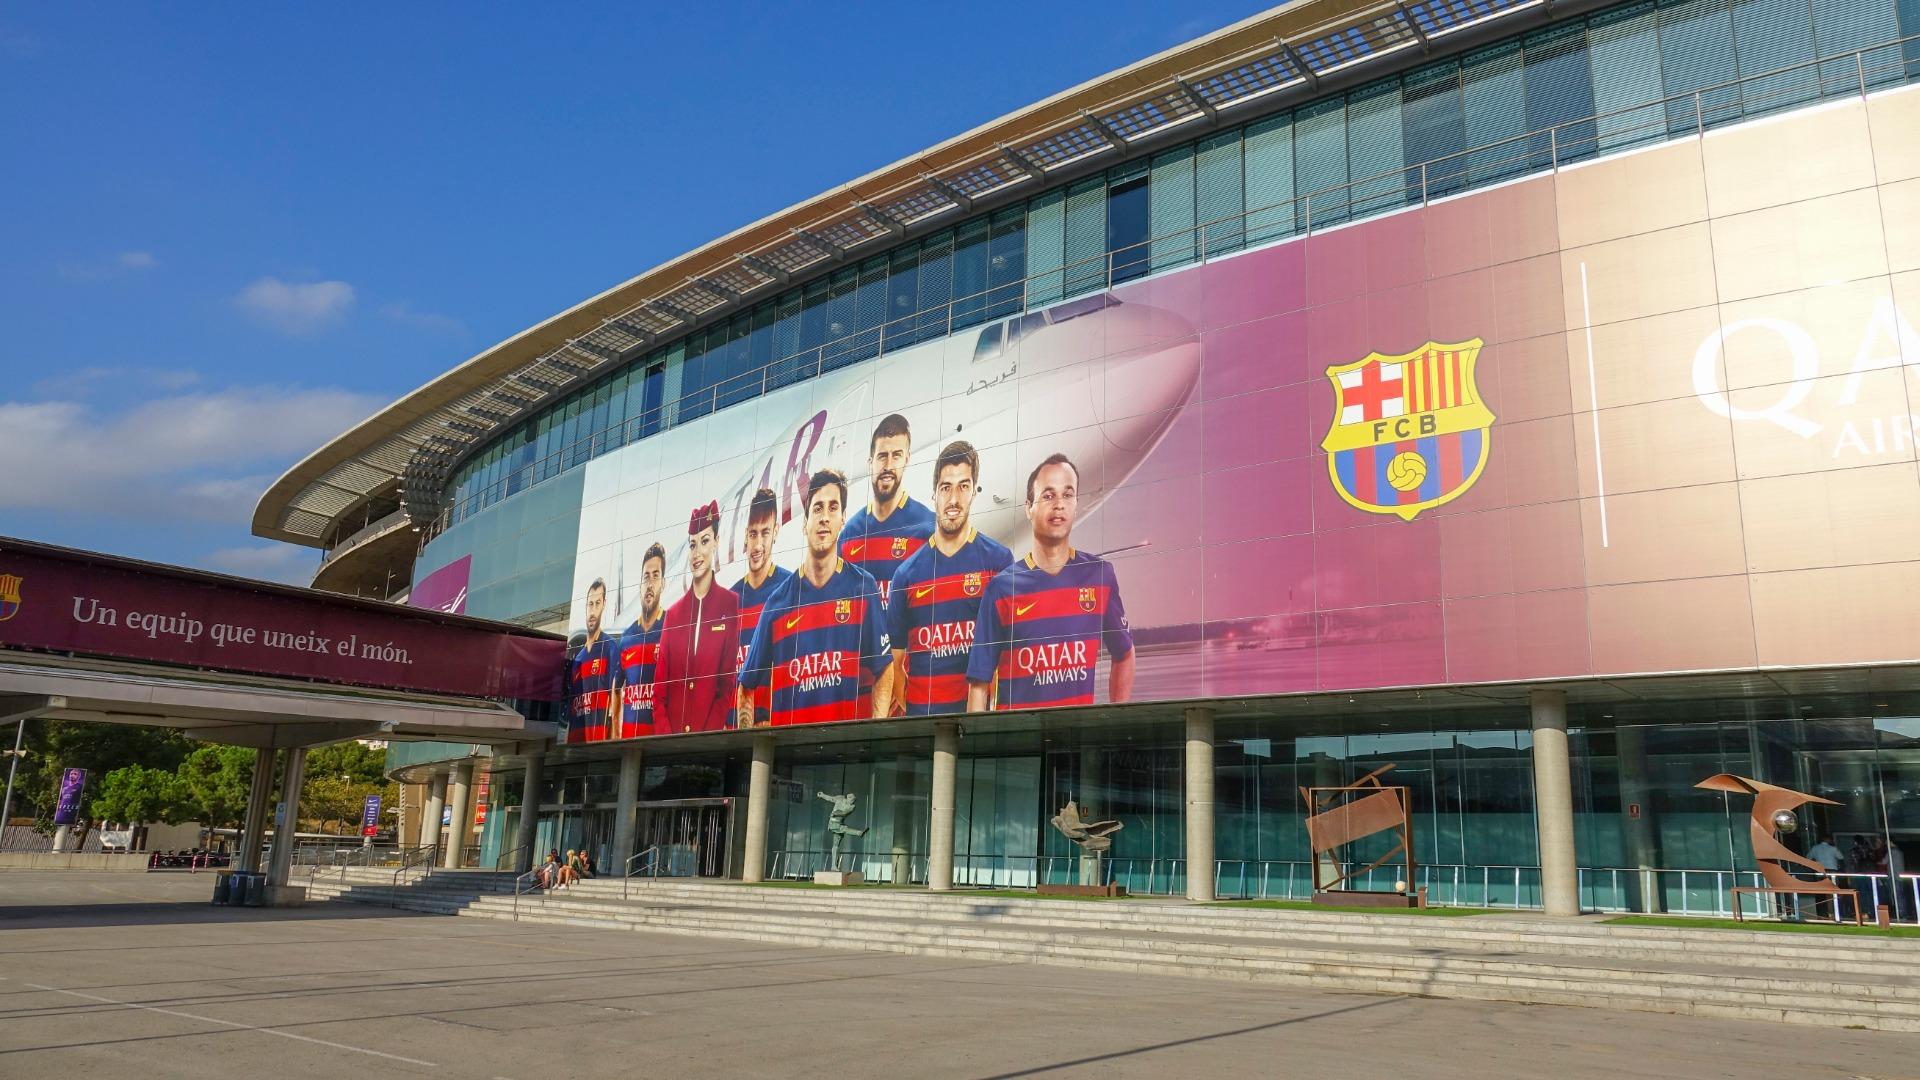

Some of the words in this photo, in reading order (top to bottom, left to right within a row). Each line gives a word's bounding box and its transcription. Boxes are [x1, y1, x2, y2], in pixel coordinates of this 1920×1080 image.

[1373, 414, 1436, 442] FCB
[73, 596, 117, 626] Un
[126, 611, 203, 643] equip
[210, 623, 256, 647] que
[264, 630, 331, 654] uneix
[337, 635, 356, 657] el
[361, 641, 413, 664] món.
[918, 620, 975, 649] QATAR
[931, 641, 973, 658] AIRWAY
[1018, 640, 1087, 674] QATAR
[789, 651, 842, 682] QATAR
[1034, 665, 1088, 686] AIRWAYS
[799, 672, 842, 693] AIRWAYS
